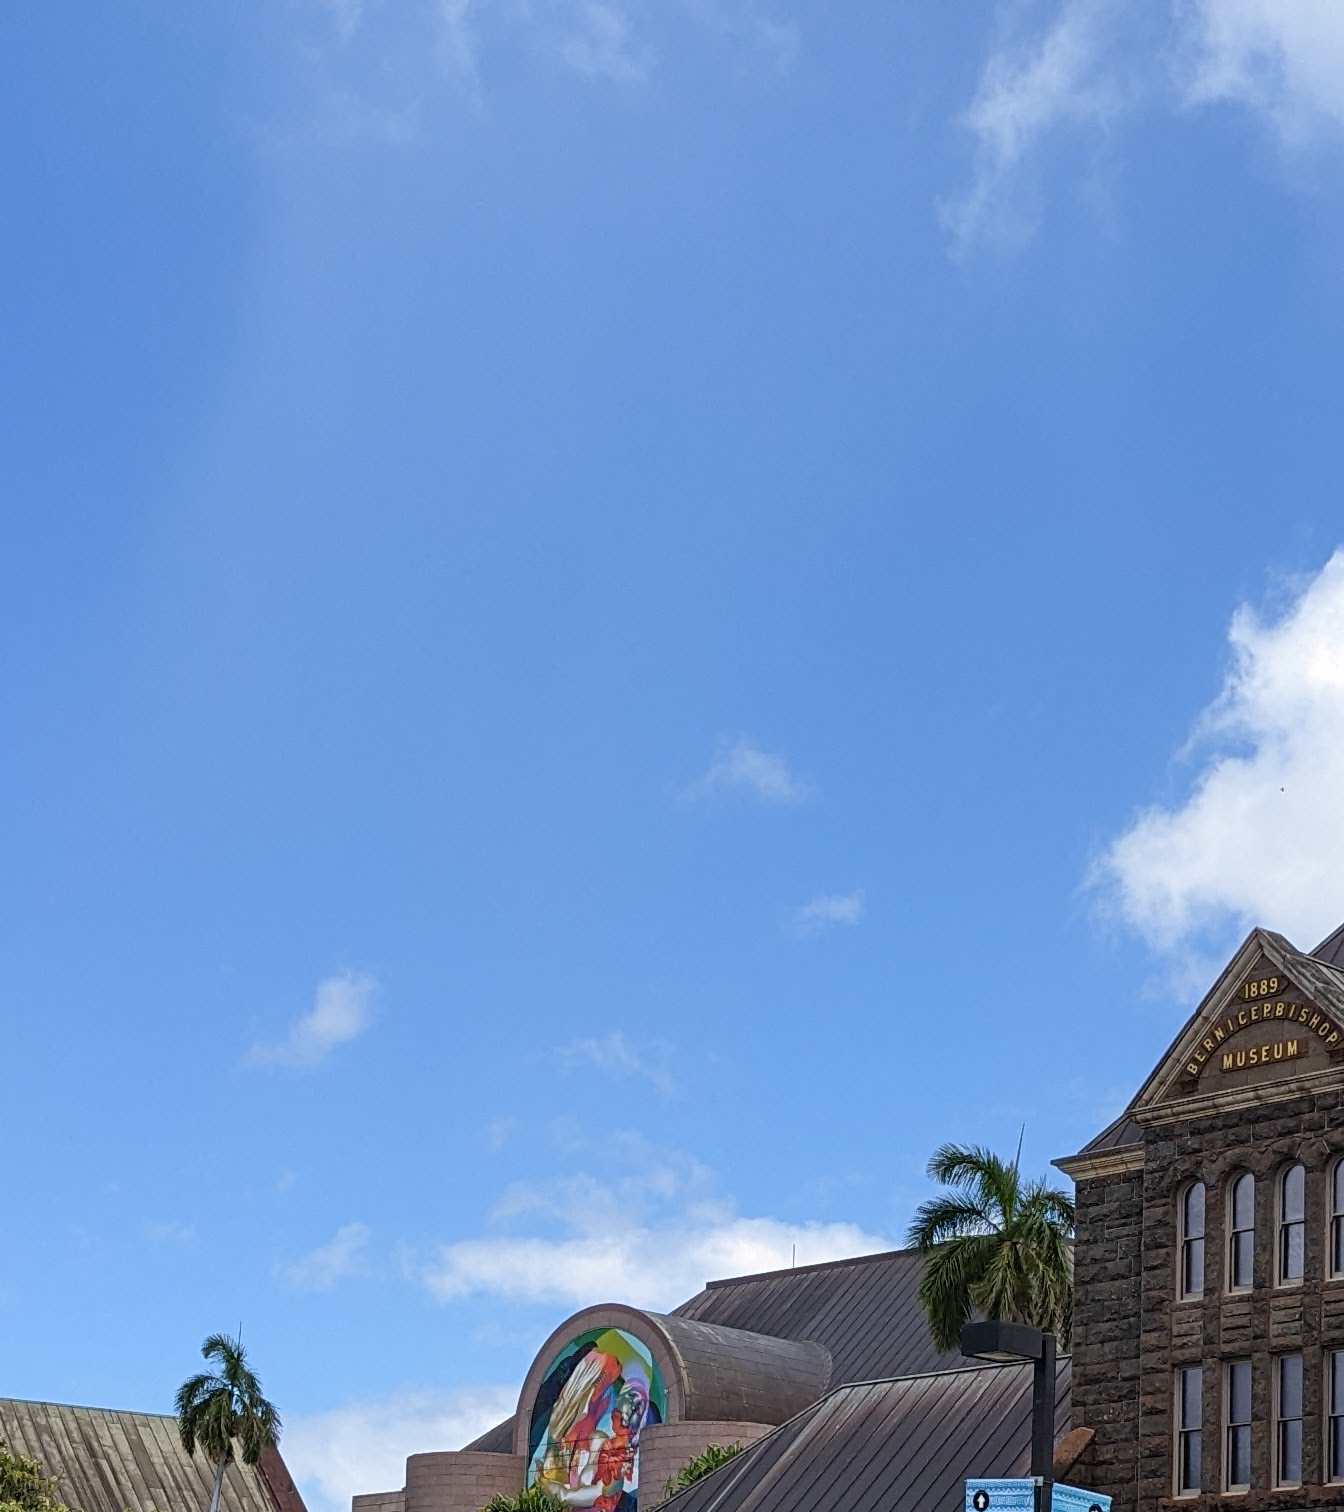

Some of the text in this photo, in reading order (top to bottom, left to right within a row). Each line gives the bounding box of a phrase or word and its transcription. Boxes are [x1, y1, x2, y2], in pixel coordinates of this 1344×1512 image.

[1244, 977, 1278, 999] 1889
[1186, 1006, 1259, 1075] BERNICE
[1275, 1002, 1339, 1045] BISHOP
[1222, 1039, 1298, 1070] MUSEUM
